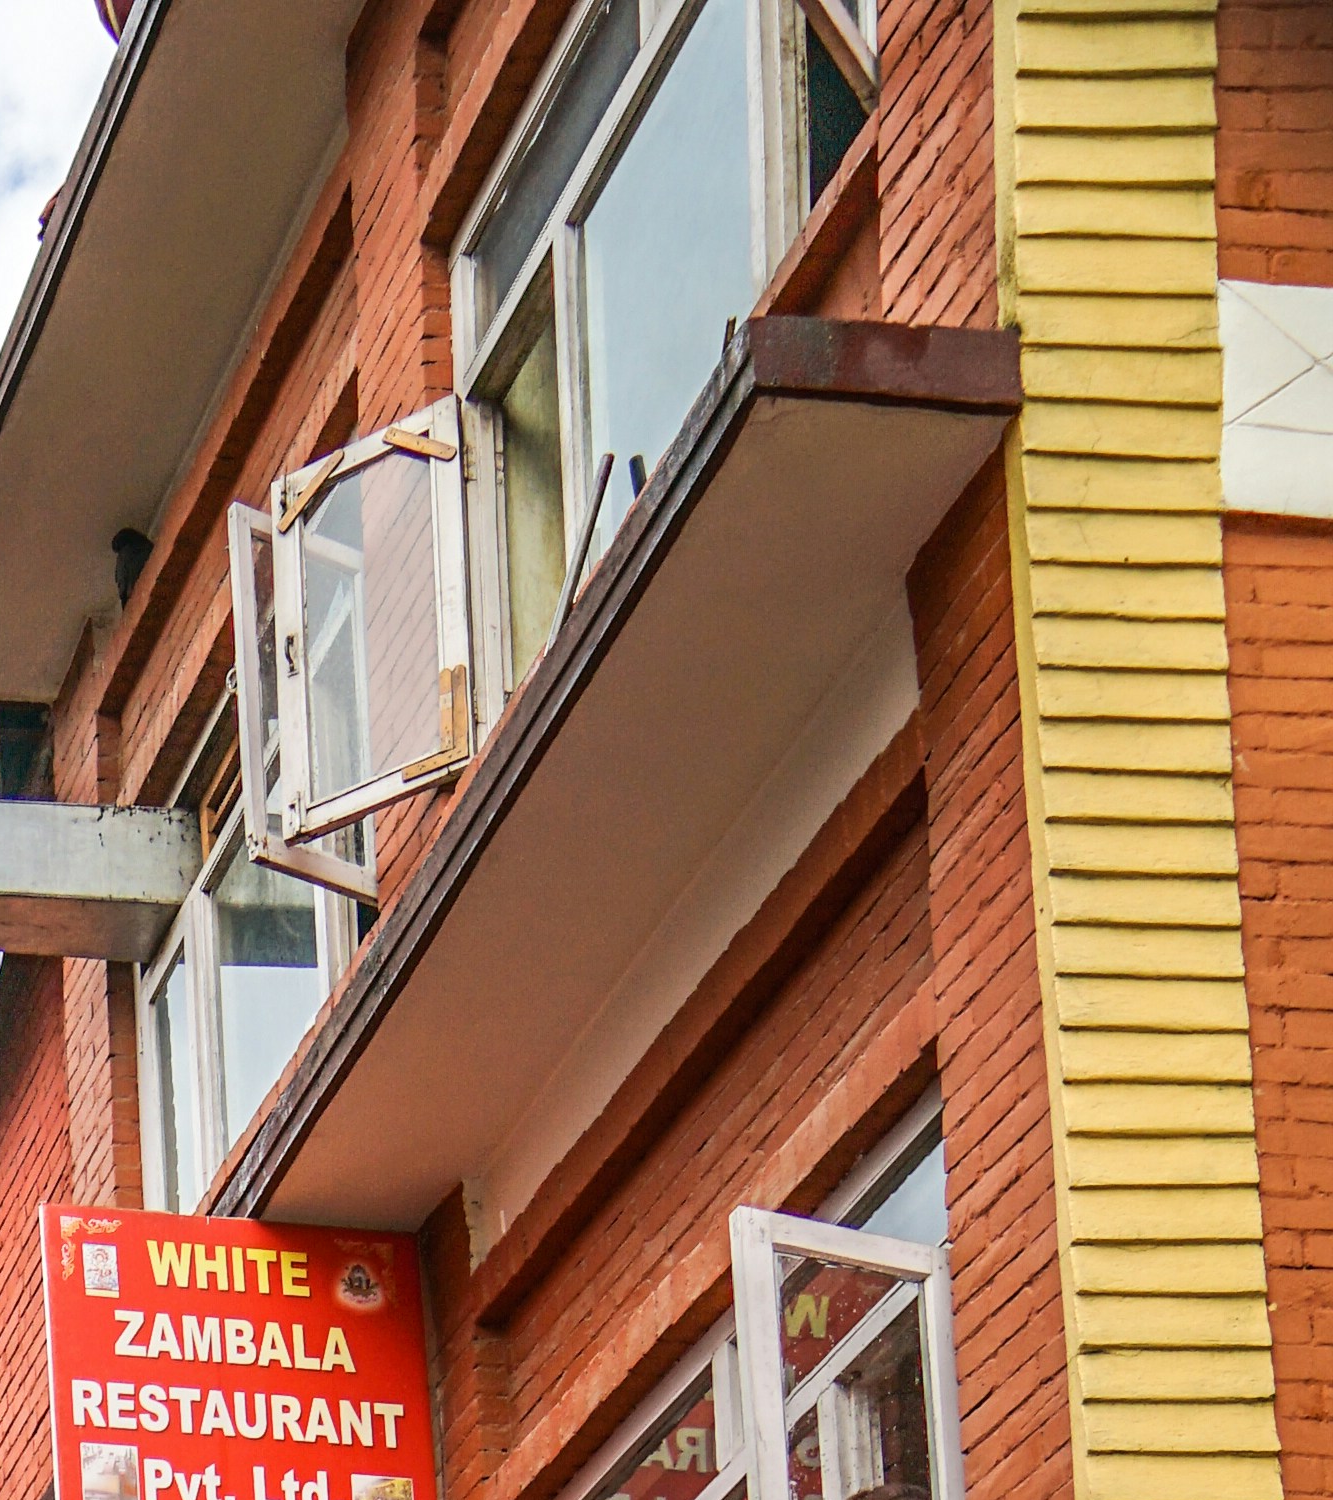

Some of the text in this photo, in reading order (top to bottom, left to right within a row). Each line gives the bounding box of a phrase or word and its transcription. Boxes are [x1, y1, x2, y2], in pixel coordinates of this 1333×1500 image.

[147, 1240, 311, 1299] WHITE
[113, 1310, 356, 1373] ZAMBALA
[71, 1379, 404, 1450] RESTAURANT
